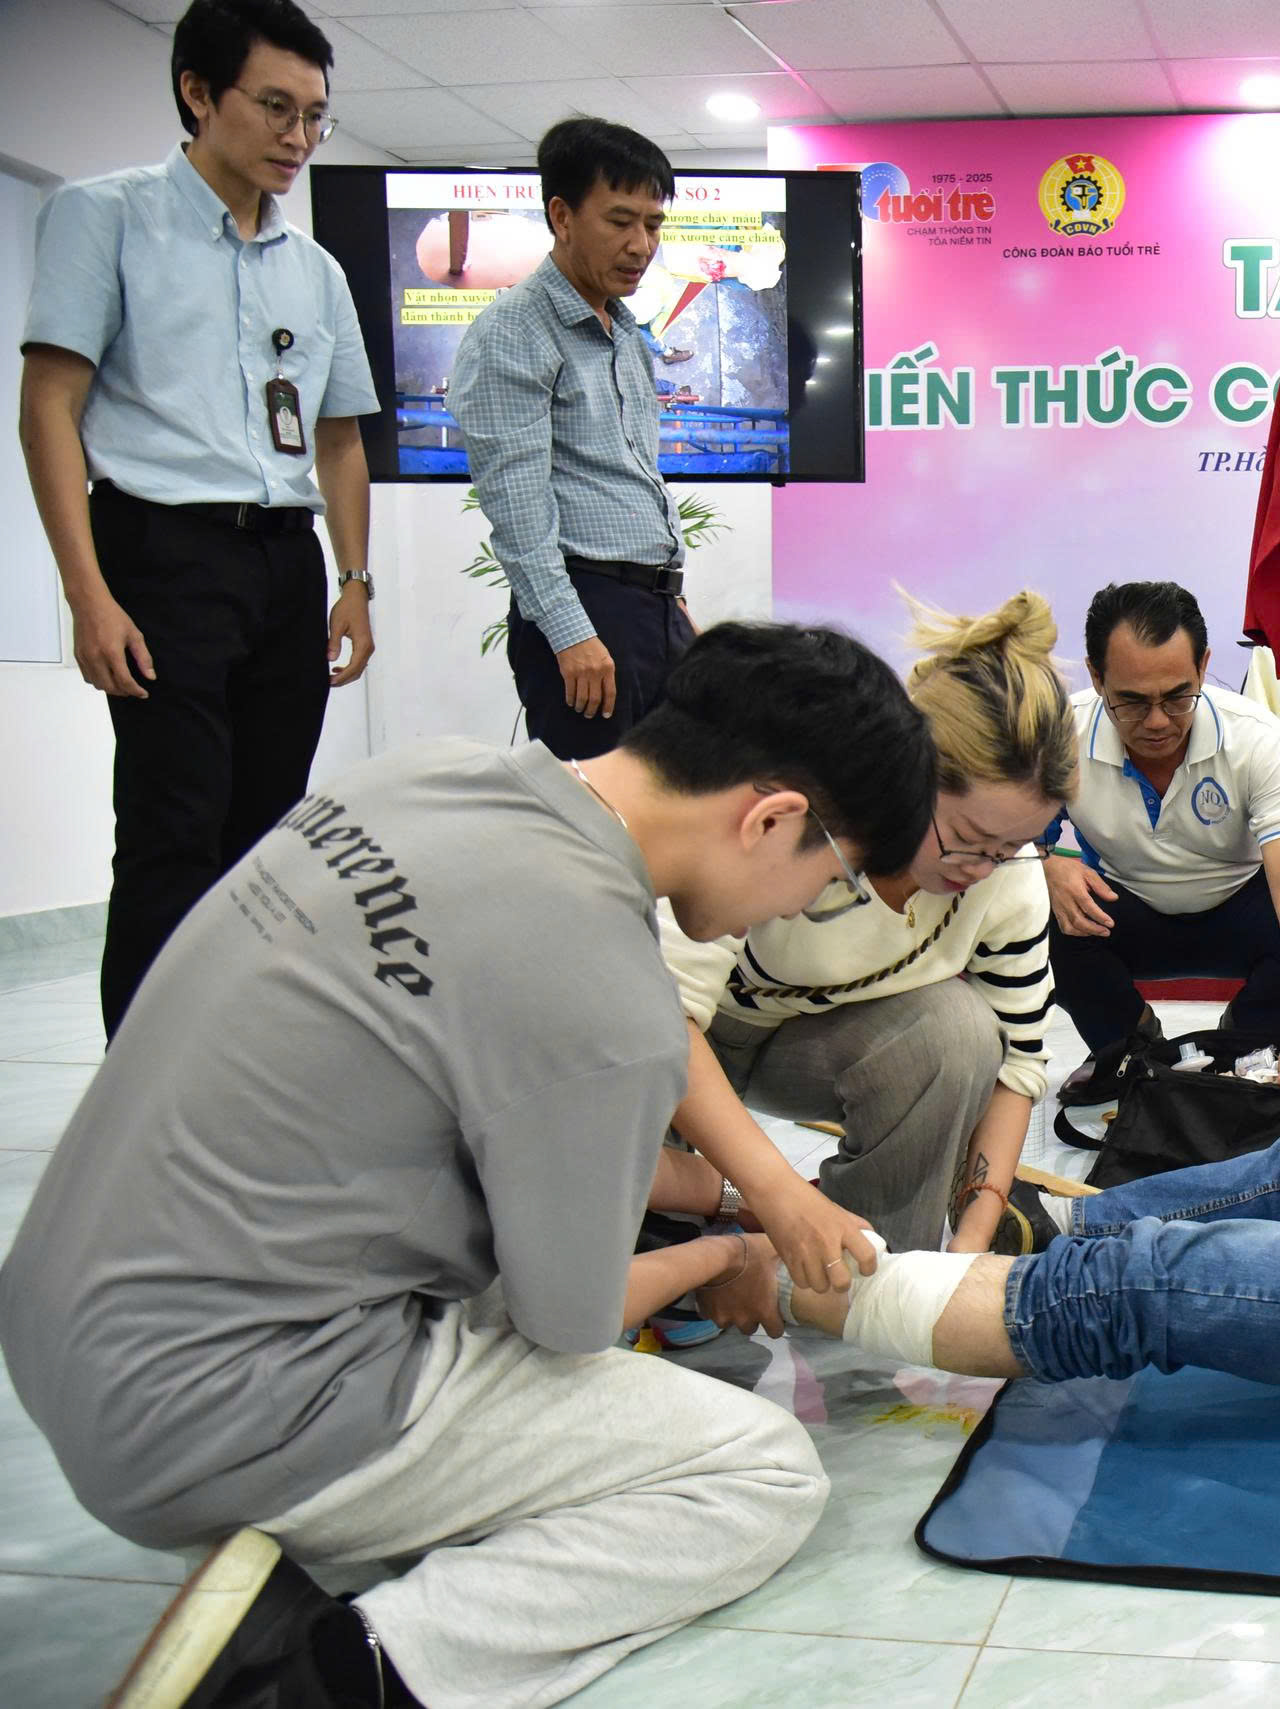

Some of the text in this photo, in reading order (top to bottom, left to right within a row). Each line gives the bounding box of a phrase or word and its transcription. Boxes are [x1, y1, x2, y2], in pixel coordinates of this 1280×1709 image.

[932, 174, 956, 184] 1975
[966, 173, 993, 183] 2025
[714, 188, 721, 201] 2
[940, 225, 974, 235] THÔNG
[976, 226, 992, 234] TIN
[977, 237, 992, 245] TIN
[1003, 241, 1161, 258] CÔNG ĐOÀN BÁO TUỔI TRẺ
[868, 346, 971, 426] IẾN
[996, 351, 1188, 426] THỨC
[1213, 365, 1280, 423] C
[1200, 789, 1222, 808] NQ
